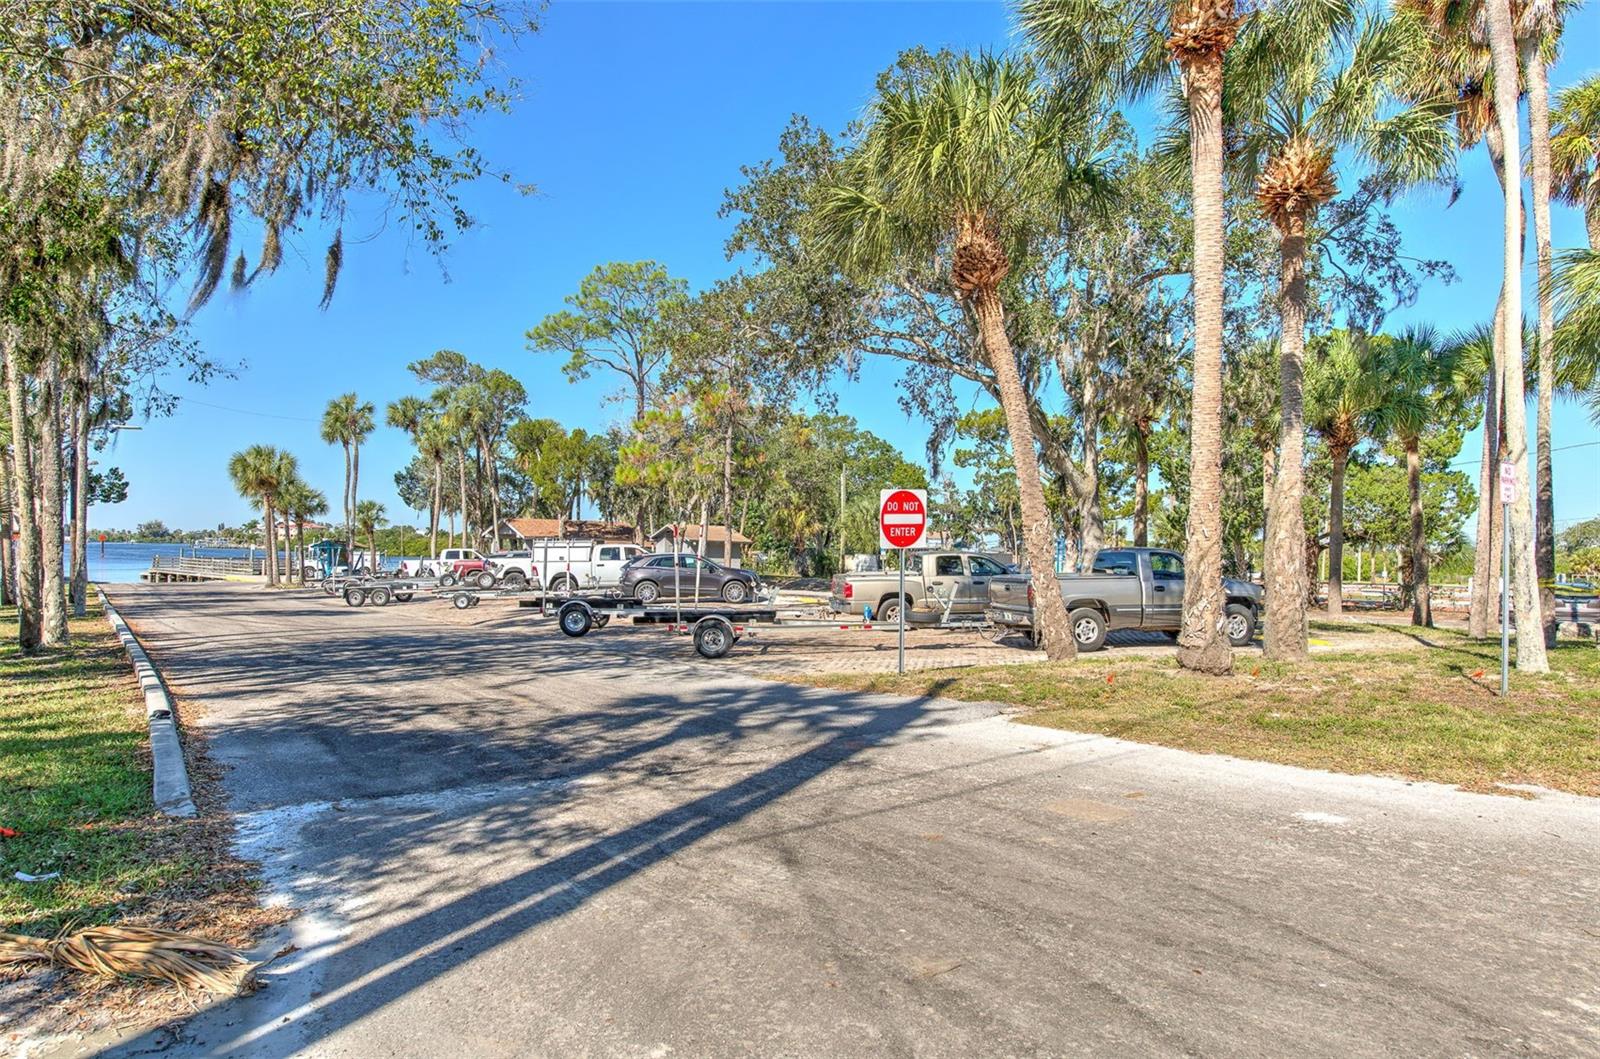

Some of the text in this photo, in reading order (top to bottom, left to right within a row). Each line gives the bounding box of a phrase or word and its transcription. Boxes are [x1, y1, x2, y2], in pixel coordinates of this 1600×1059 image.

[887, 502, 919, 511] DO NOT
[890, 527, 916, 537] ENTER
